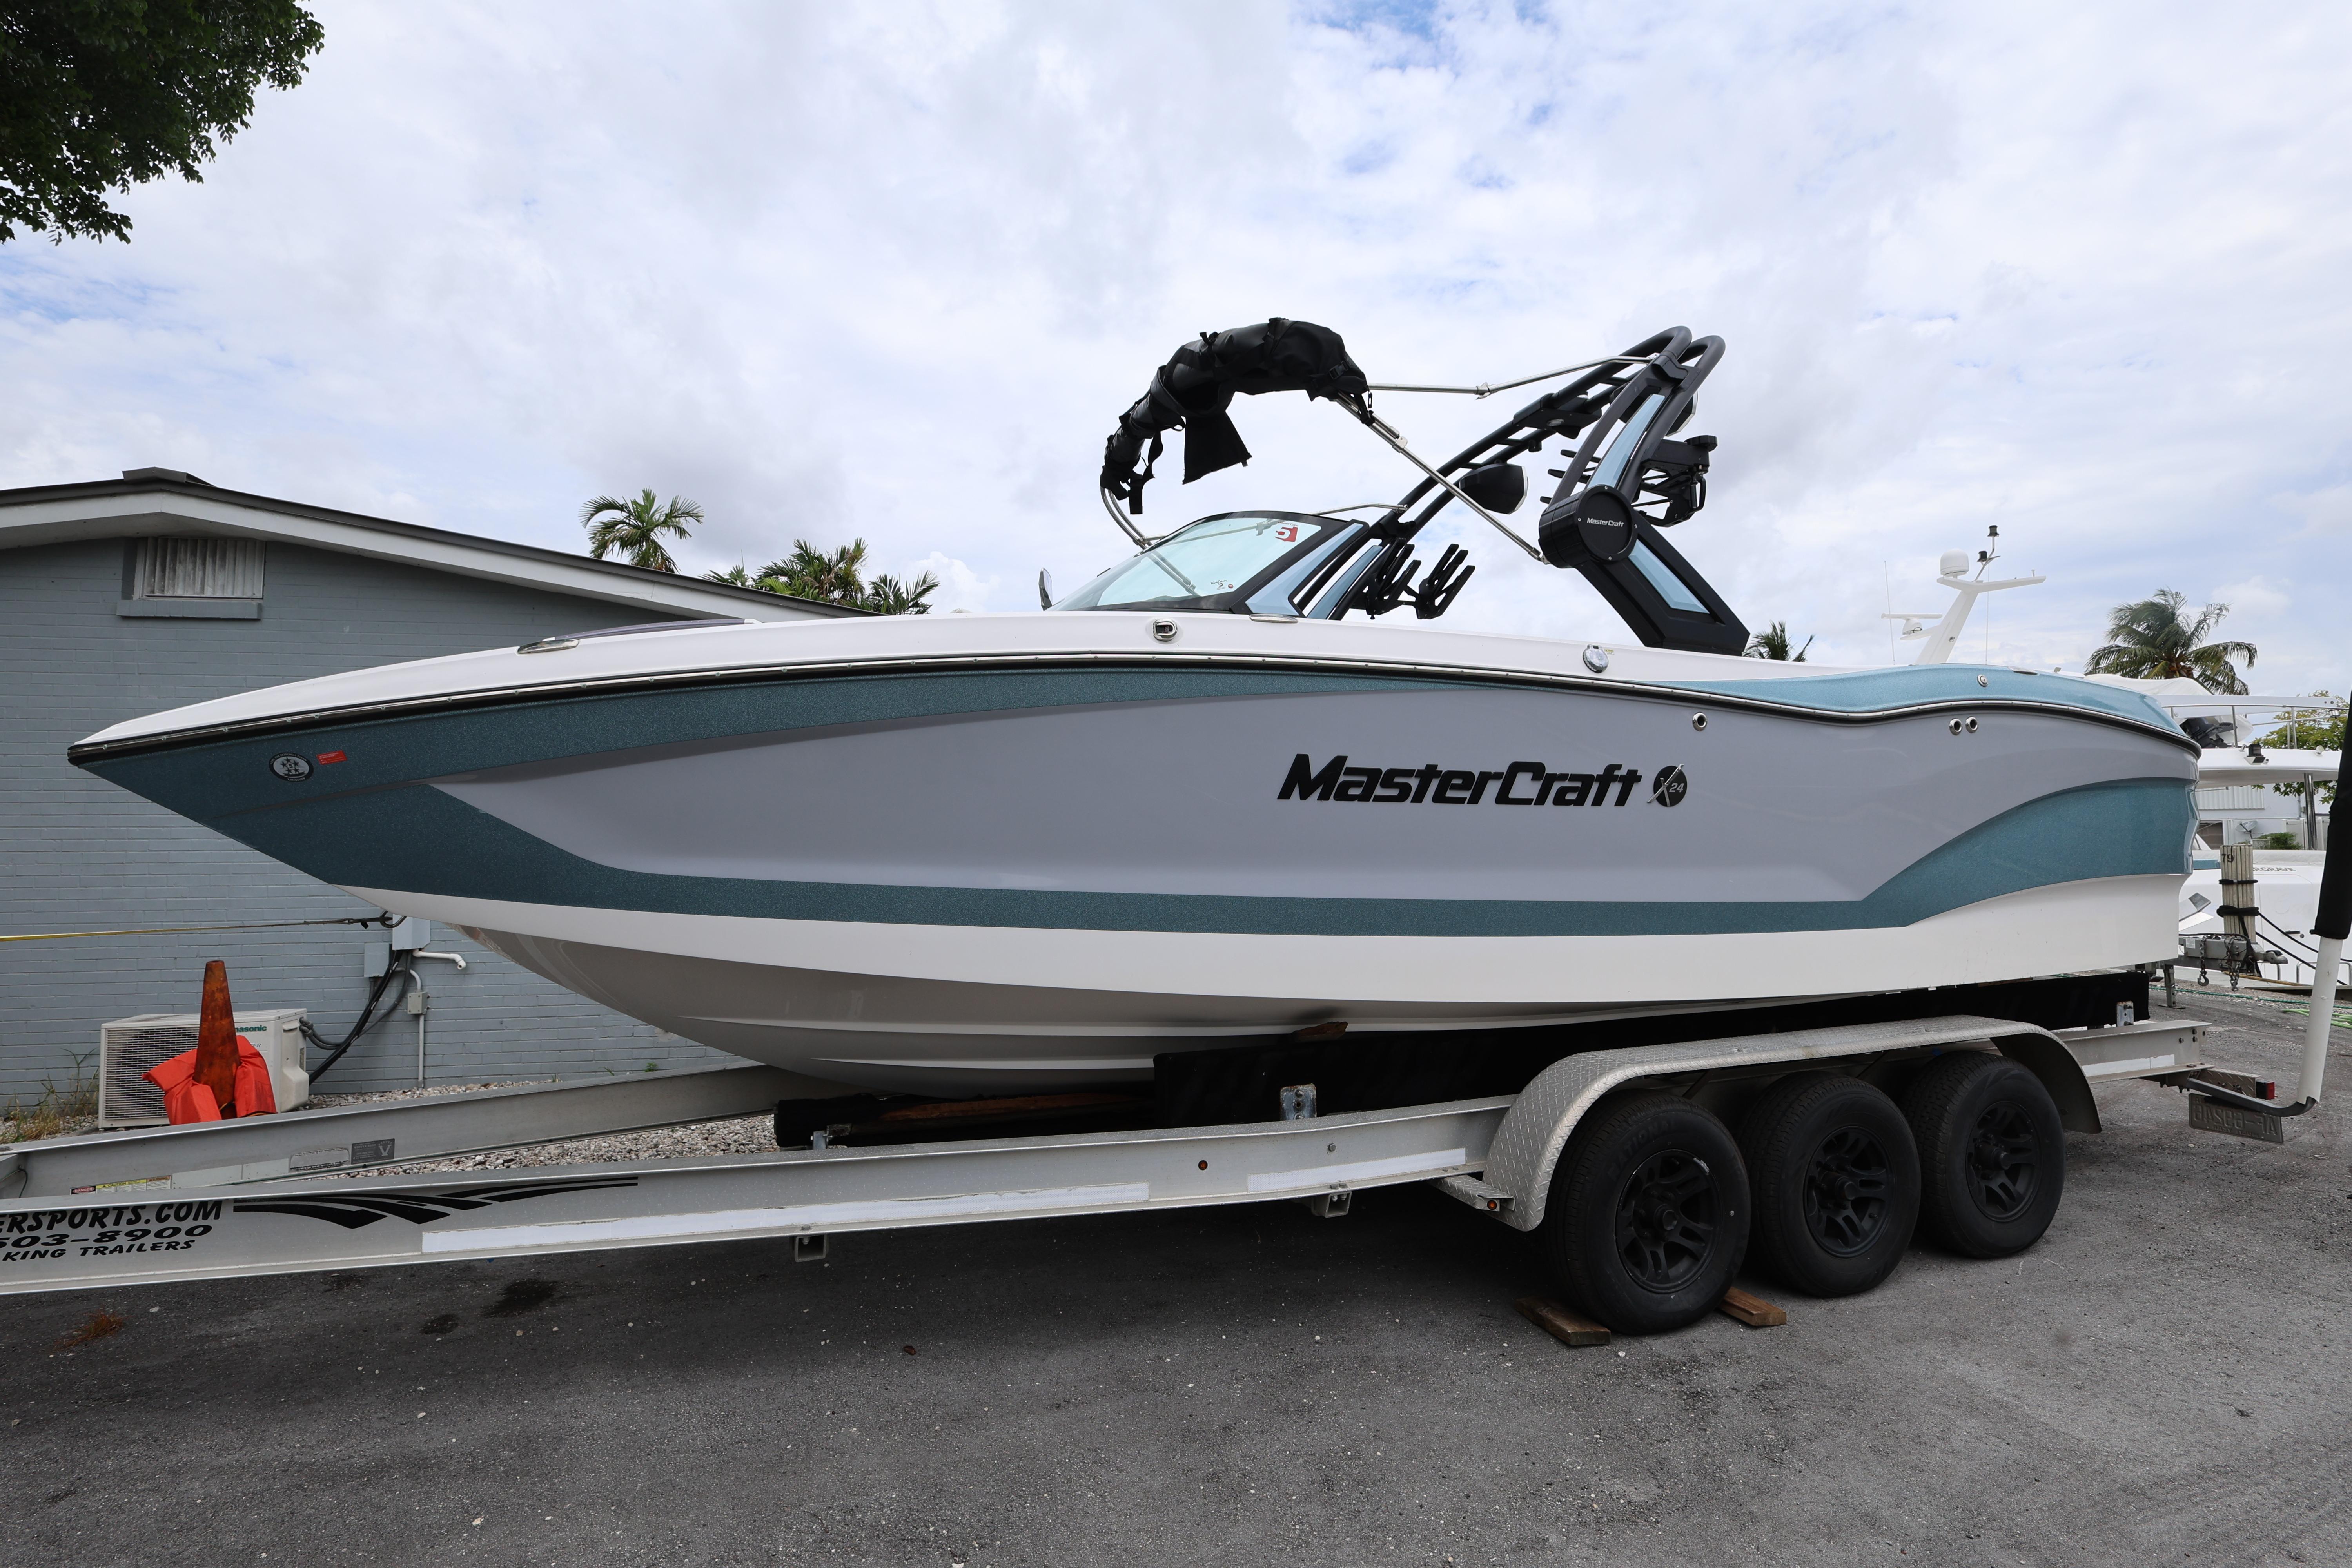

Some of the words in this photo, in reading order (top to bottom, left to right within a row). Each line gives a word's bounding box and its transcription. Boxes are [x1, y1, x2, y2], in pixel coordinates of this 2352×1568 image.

[1586, 517, 1624, 528] MasterCraft
[1277, 753, 1642, 806] MasterCraft
[2221, 853, 2234, 863] 79
[2, 1248, 66, 1262] KING
[80, 1240, 196, 1256] TRAILERS
